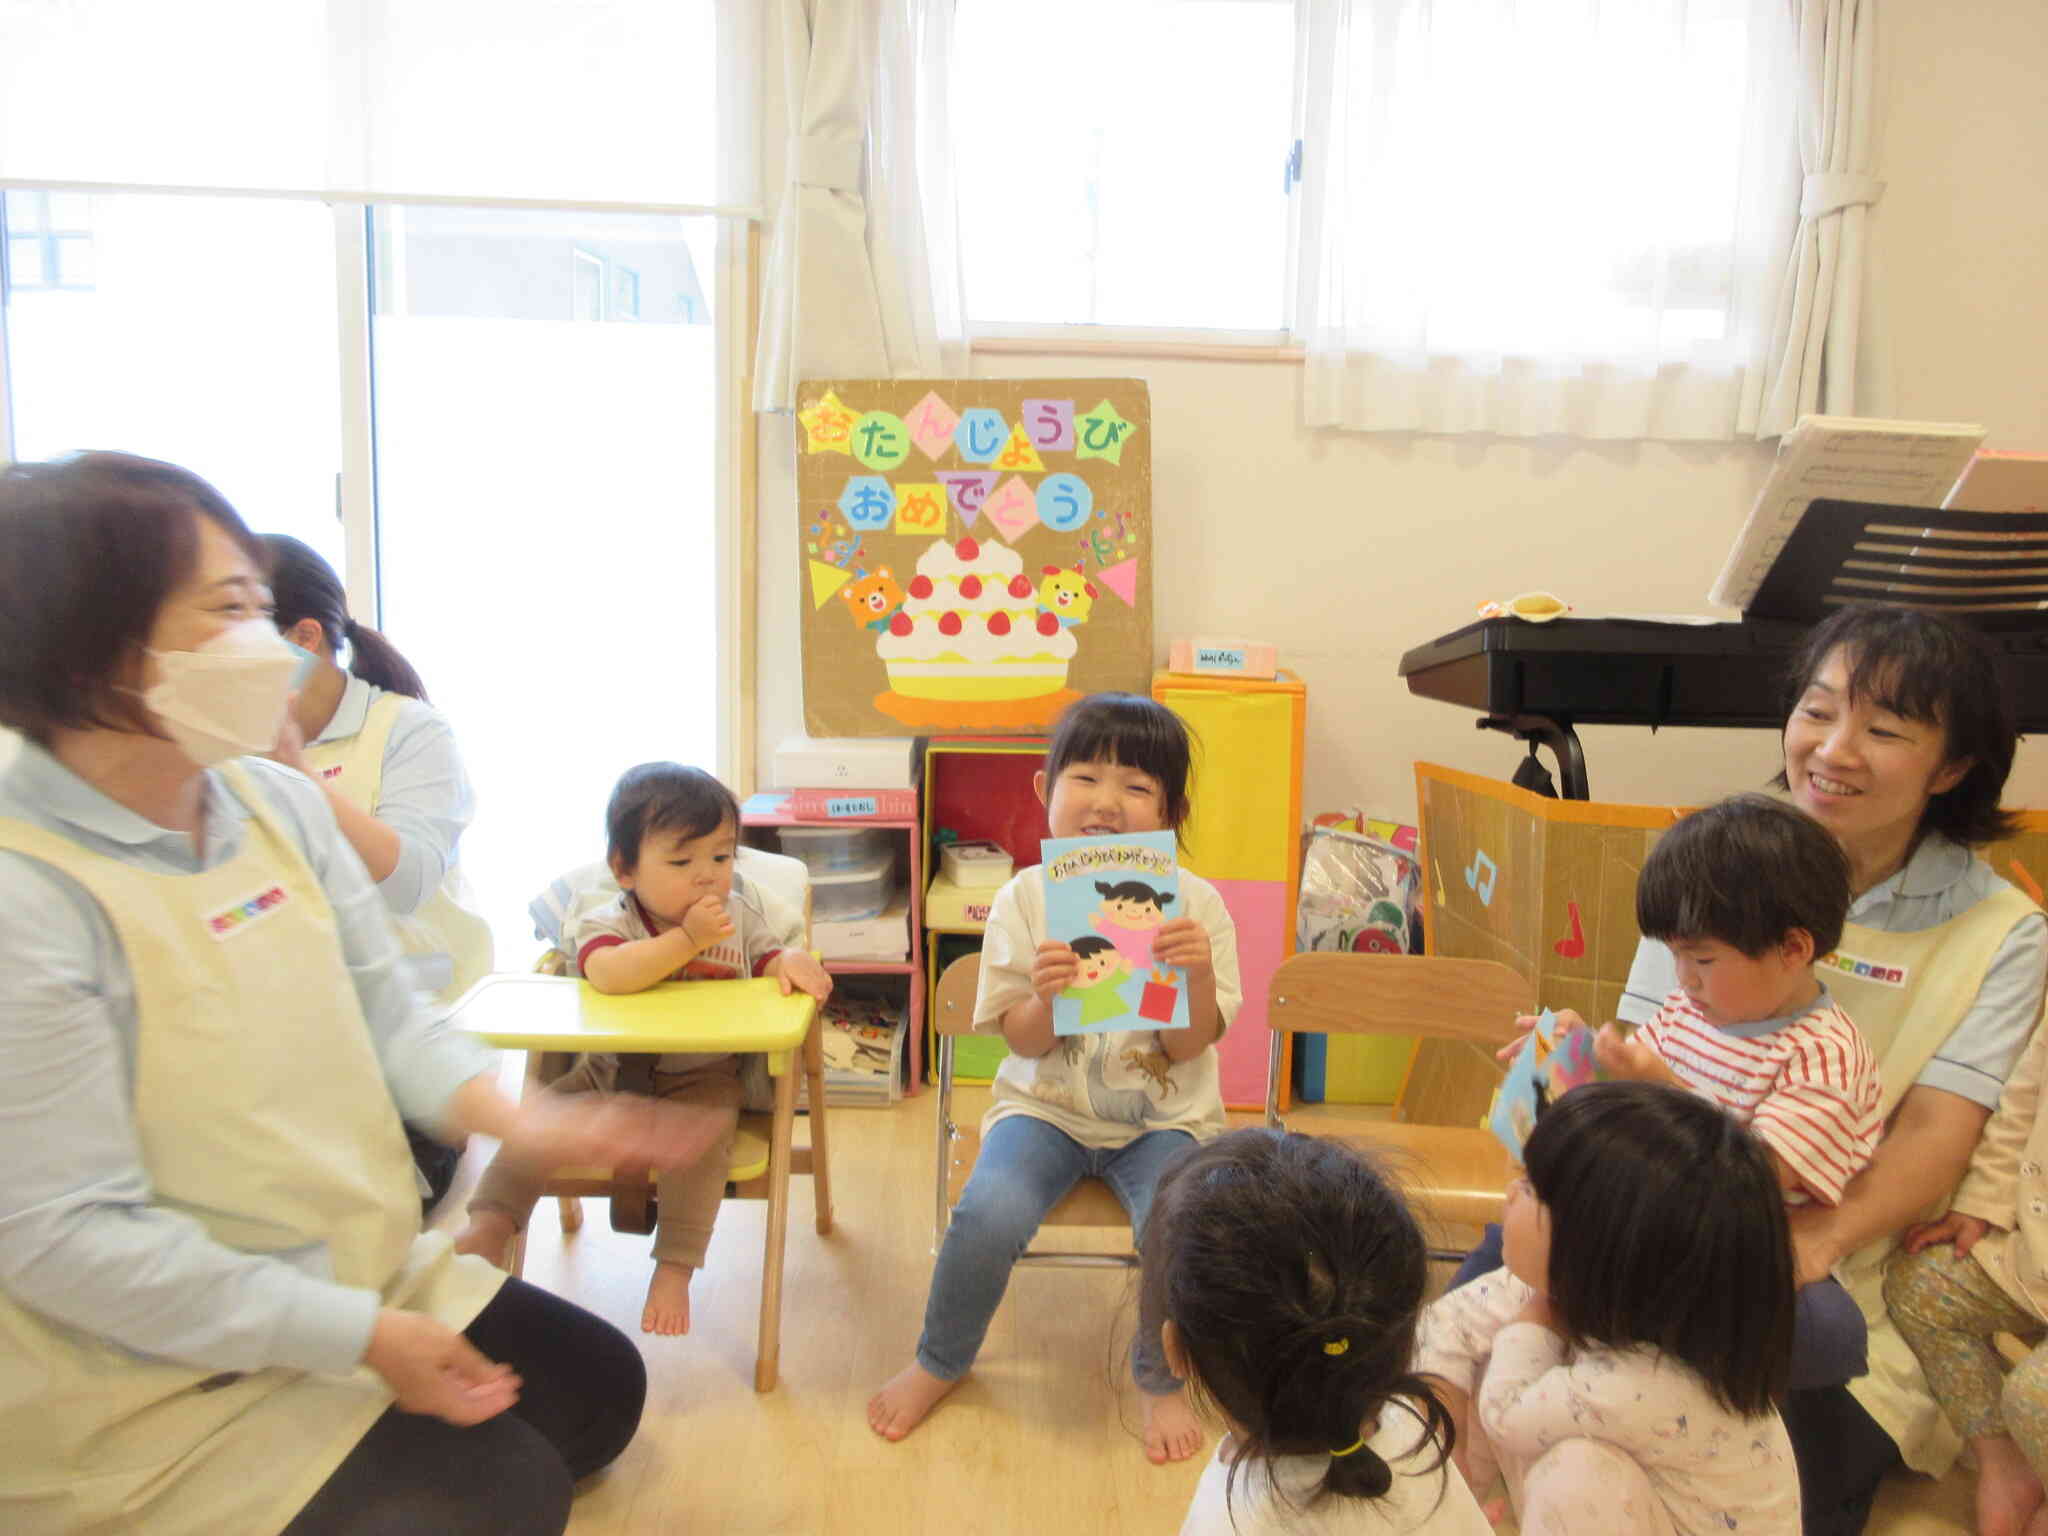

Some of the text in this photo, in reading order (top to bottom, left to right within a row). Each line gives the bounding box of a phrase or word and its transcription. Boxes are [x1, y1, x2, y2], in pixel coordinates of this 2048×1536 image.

[851, 477, 1080, 527] おめでとう
